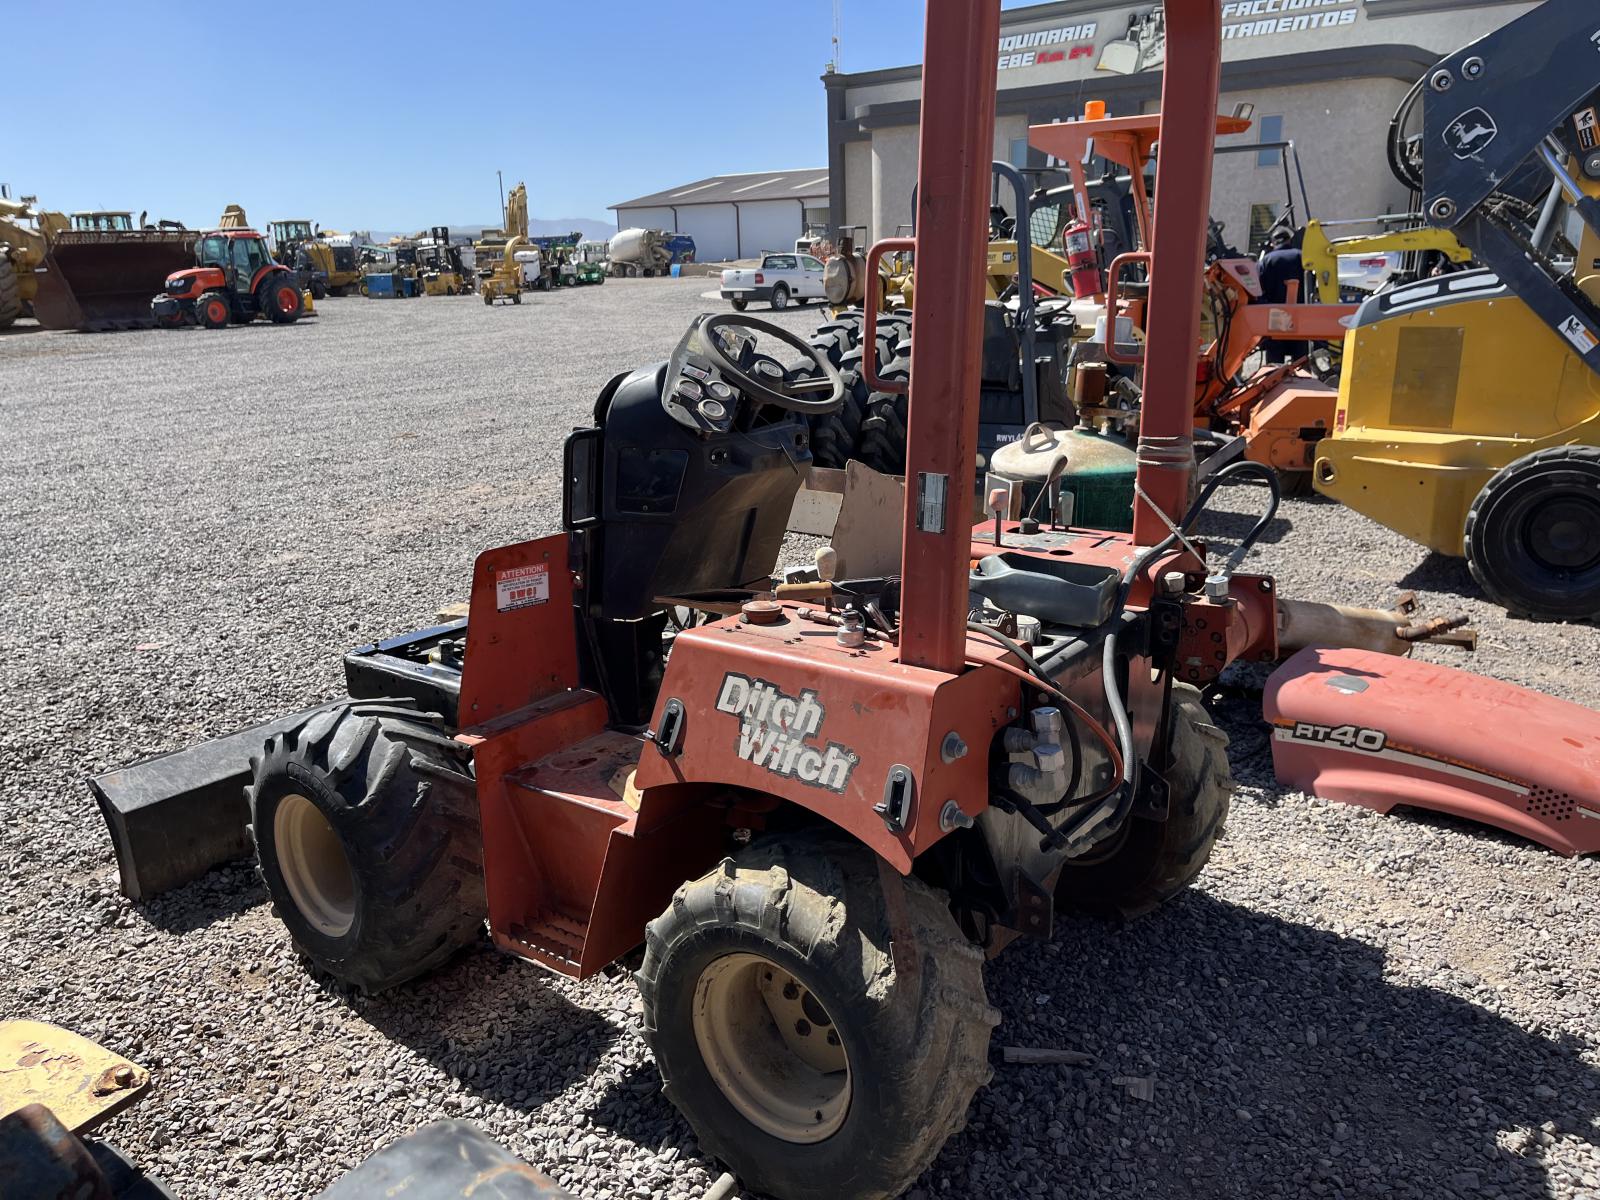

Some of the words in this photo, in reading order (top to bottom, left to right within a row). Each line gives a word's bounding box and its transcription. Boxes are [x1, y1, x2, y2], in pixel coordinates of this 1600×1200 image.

[1222, 0, 1354, 18] FACCION
[501, 564, 544, 580] ATTENTION!
[716, 674, 823, 735] Ditch
[738, 722, 851, 790] Witch
